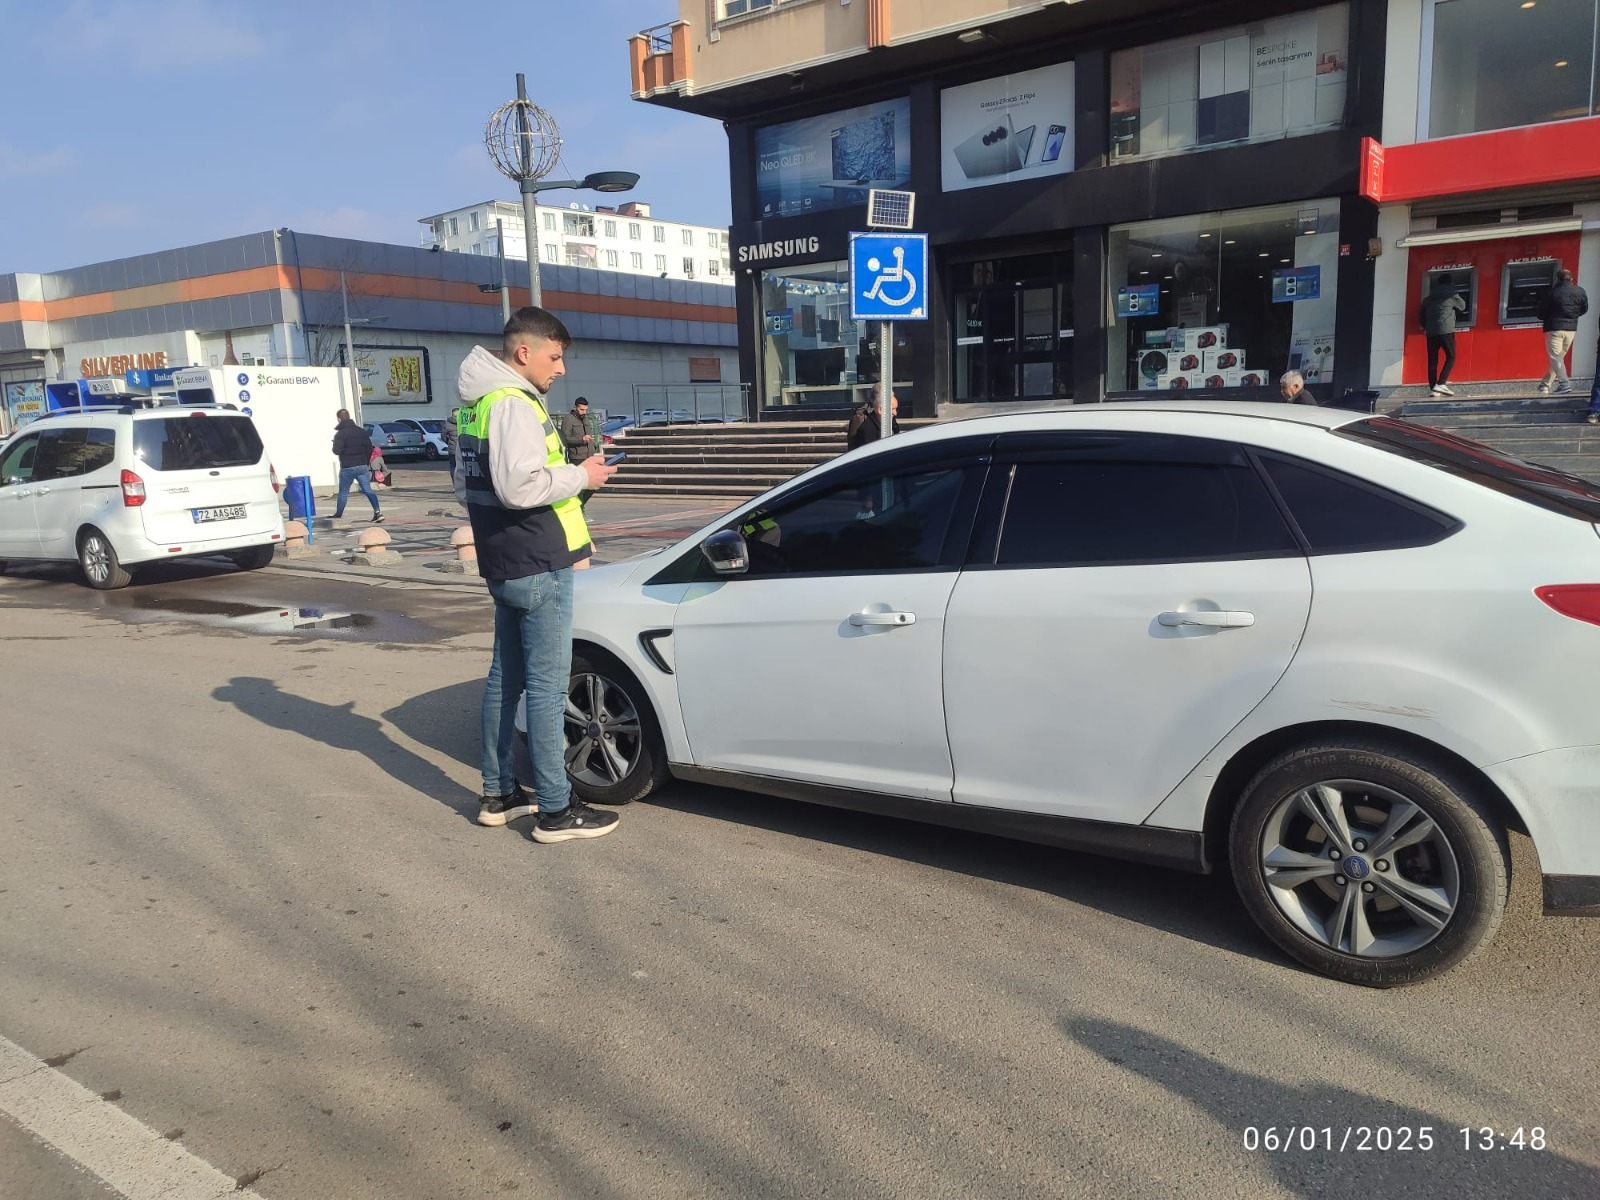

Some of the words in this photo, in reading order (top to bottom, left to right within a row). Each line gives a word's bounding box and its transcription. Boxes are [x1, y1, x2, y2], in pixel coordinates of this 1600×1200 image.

[1256, 40, 1297, 56] BESPOKE
[760, 160, 780, 171] Neo
[780, 153, 804, 167] QLED
[738, 236, 819, 262] SAMSUNG
[81, 352, 167, 378] SILVERLINE
[266, 376, 295, 385] Garanti
[295, 376, 320, 385] BBVA
[198, 510, 210, 520] 72
[213, 506, 247, 519] AAS485
